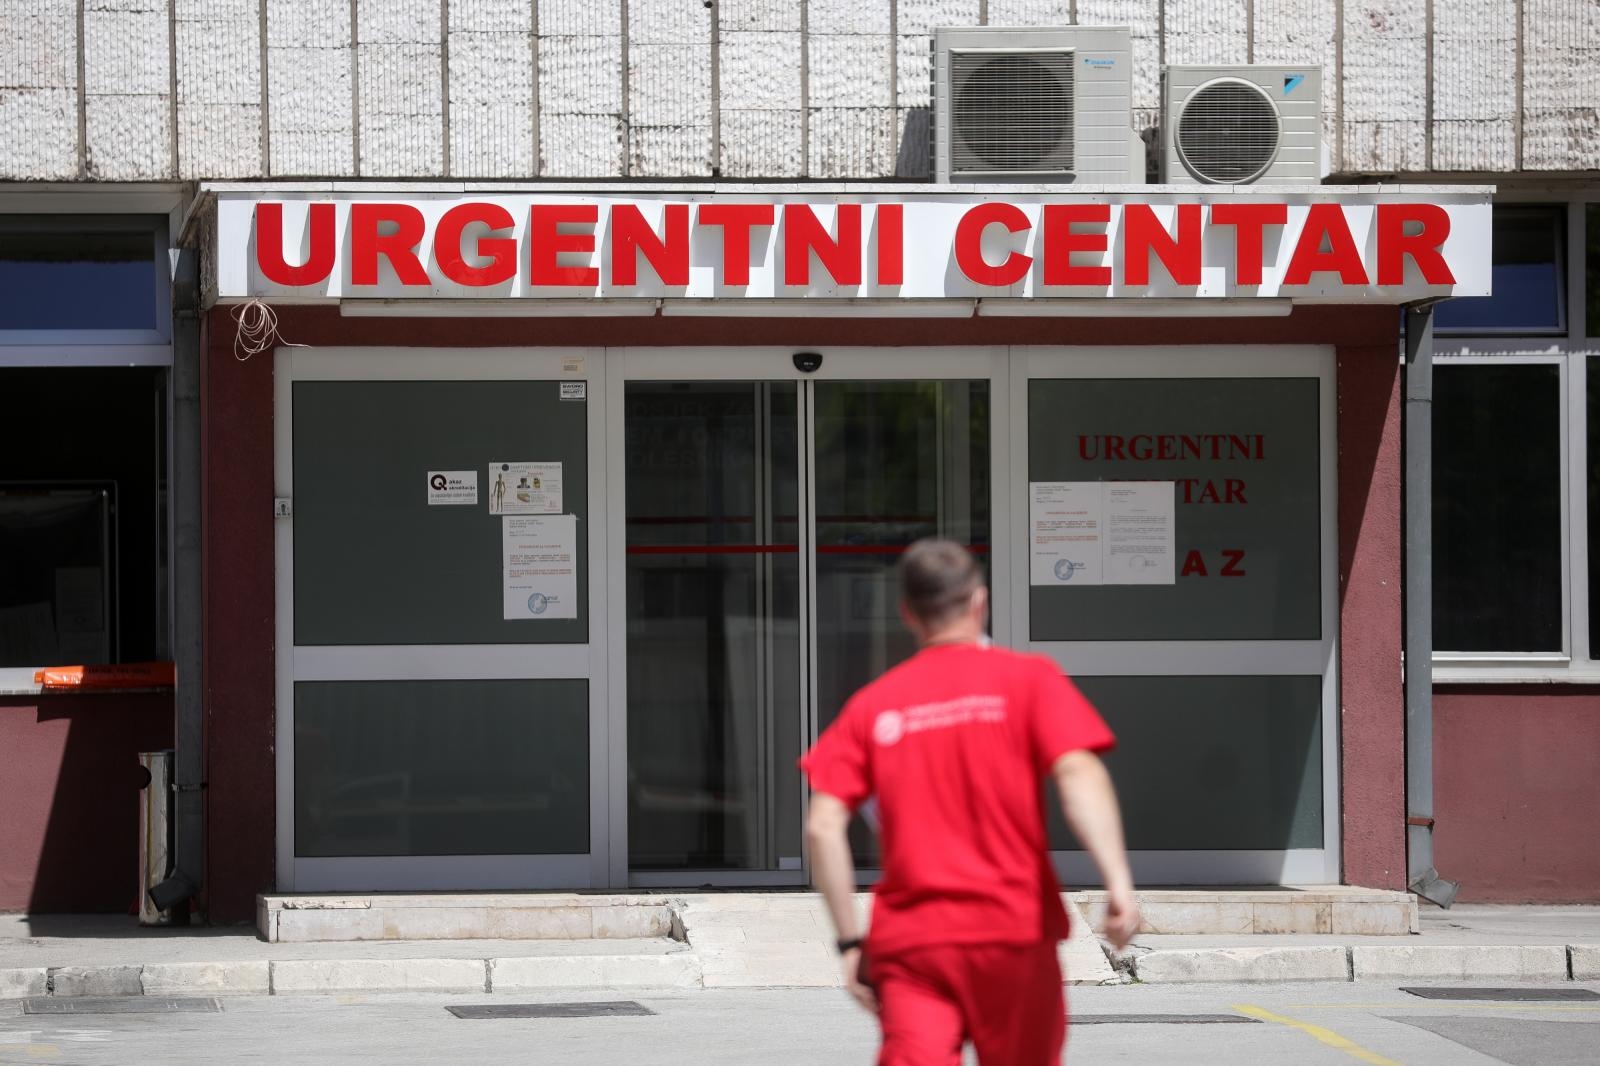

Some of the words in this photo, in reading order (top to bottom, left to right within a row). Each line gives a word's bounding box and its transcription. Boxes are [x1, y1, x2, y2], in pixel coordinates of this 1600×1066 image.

[256, 202, 904, 286] URGENTNI
[955, 202, 1455, 286] CENTAR
[1078, 435, 1266, 461] URGENTNI
